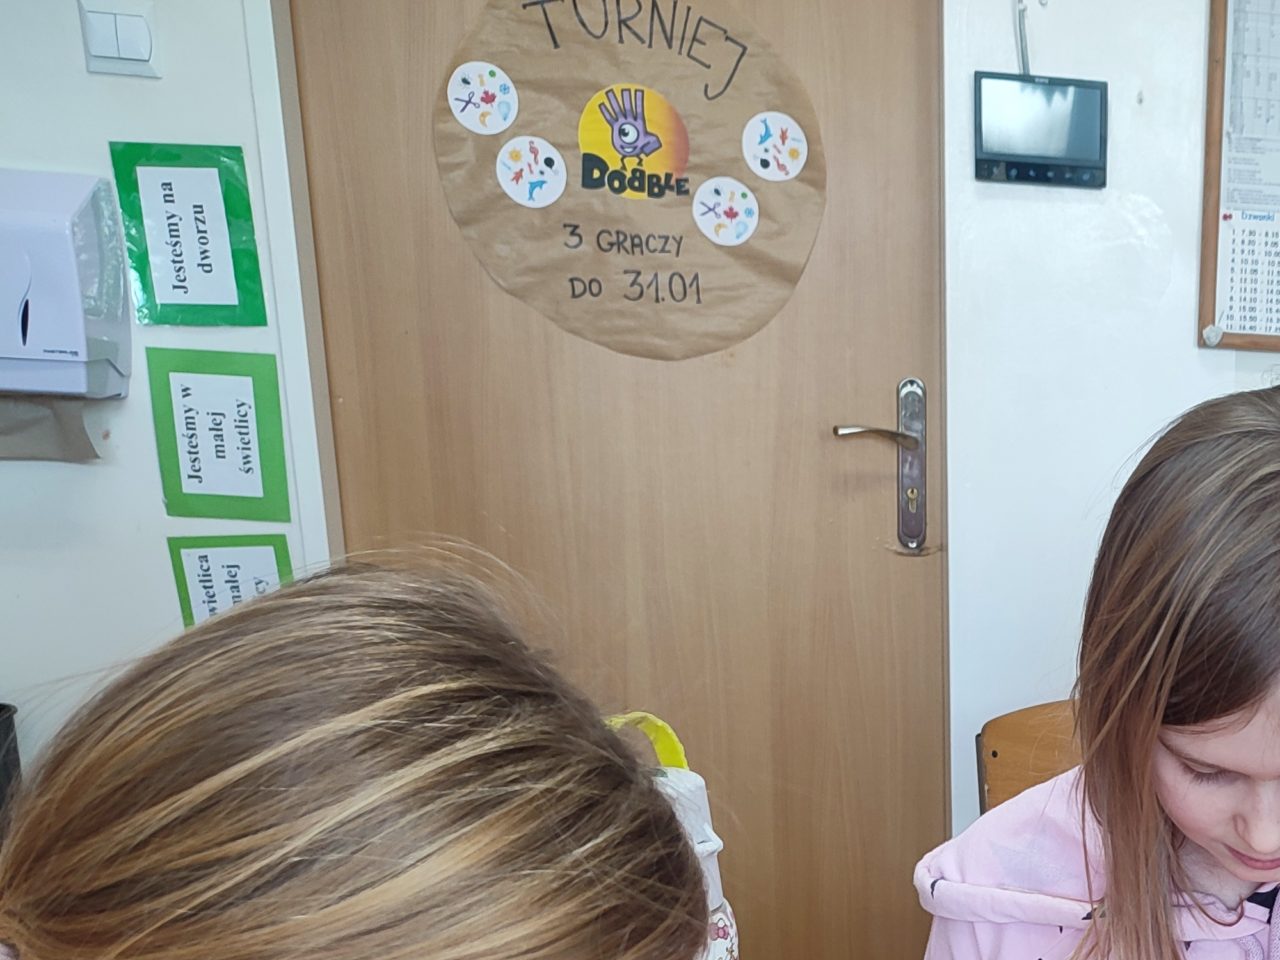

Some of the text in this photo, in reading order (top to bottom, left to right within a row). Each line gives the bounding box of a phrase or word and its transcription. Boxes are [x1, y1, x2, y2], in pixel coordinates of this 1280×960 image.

[522, 0, 748, 100] TURNIEJ
[581, 153, 690, 198] DOBBLE
[161, 182, 189, 294] Jesteśmy na
[193, 204, 213, 274] dworzu
[563, 223, 683, 257] 3 GRACZY
[569, 270, 702, 304] DO 31.01
[180, 384, 203, 484] Jesteśmy w
[233, 399, 254, 474] świetlicy
